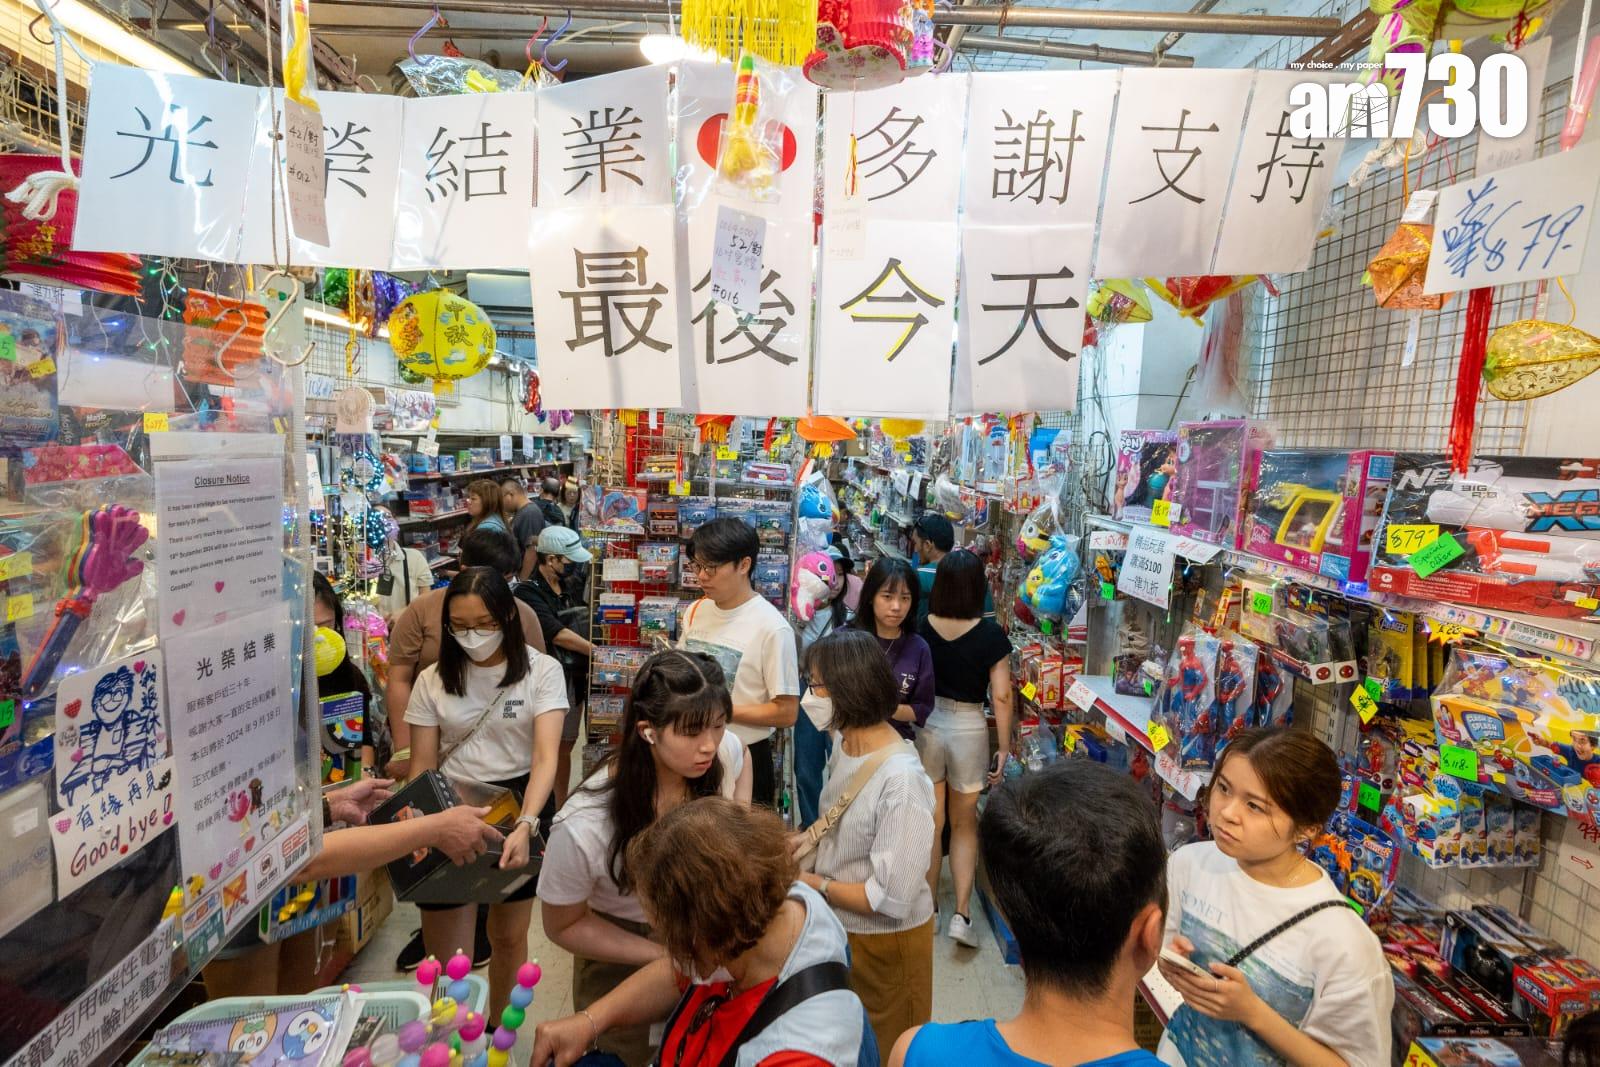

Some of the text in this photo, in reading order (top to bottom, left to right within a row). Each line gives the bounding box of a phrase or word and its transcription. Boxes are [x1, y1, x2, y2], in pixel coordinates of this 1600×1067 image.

[558, 245, 1081, 366] 最後今天
[194, 473, 250, 486] Closure Notice
[197, 632, 276, 681] 光榮結業
[226, 728, 244, 745] 2024
[76, 769, 159, 832] 有緣再見
[70, 824, 121, 877] Good
